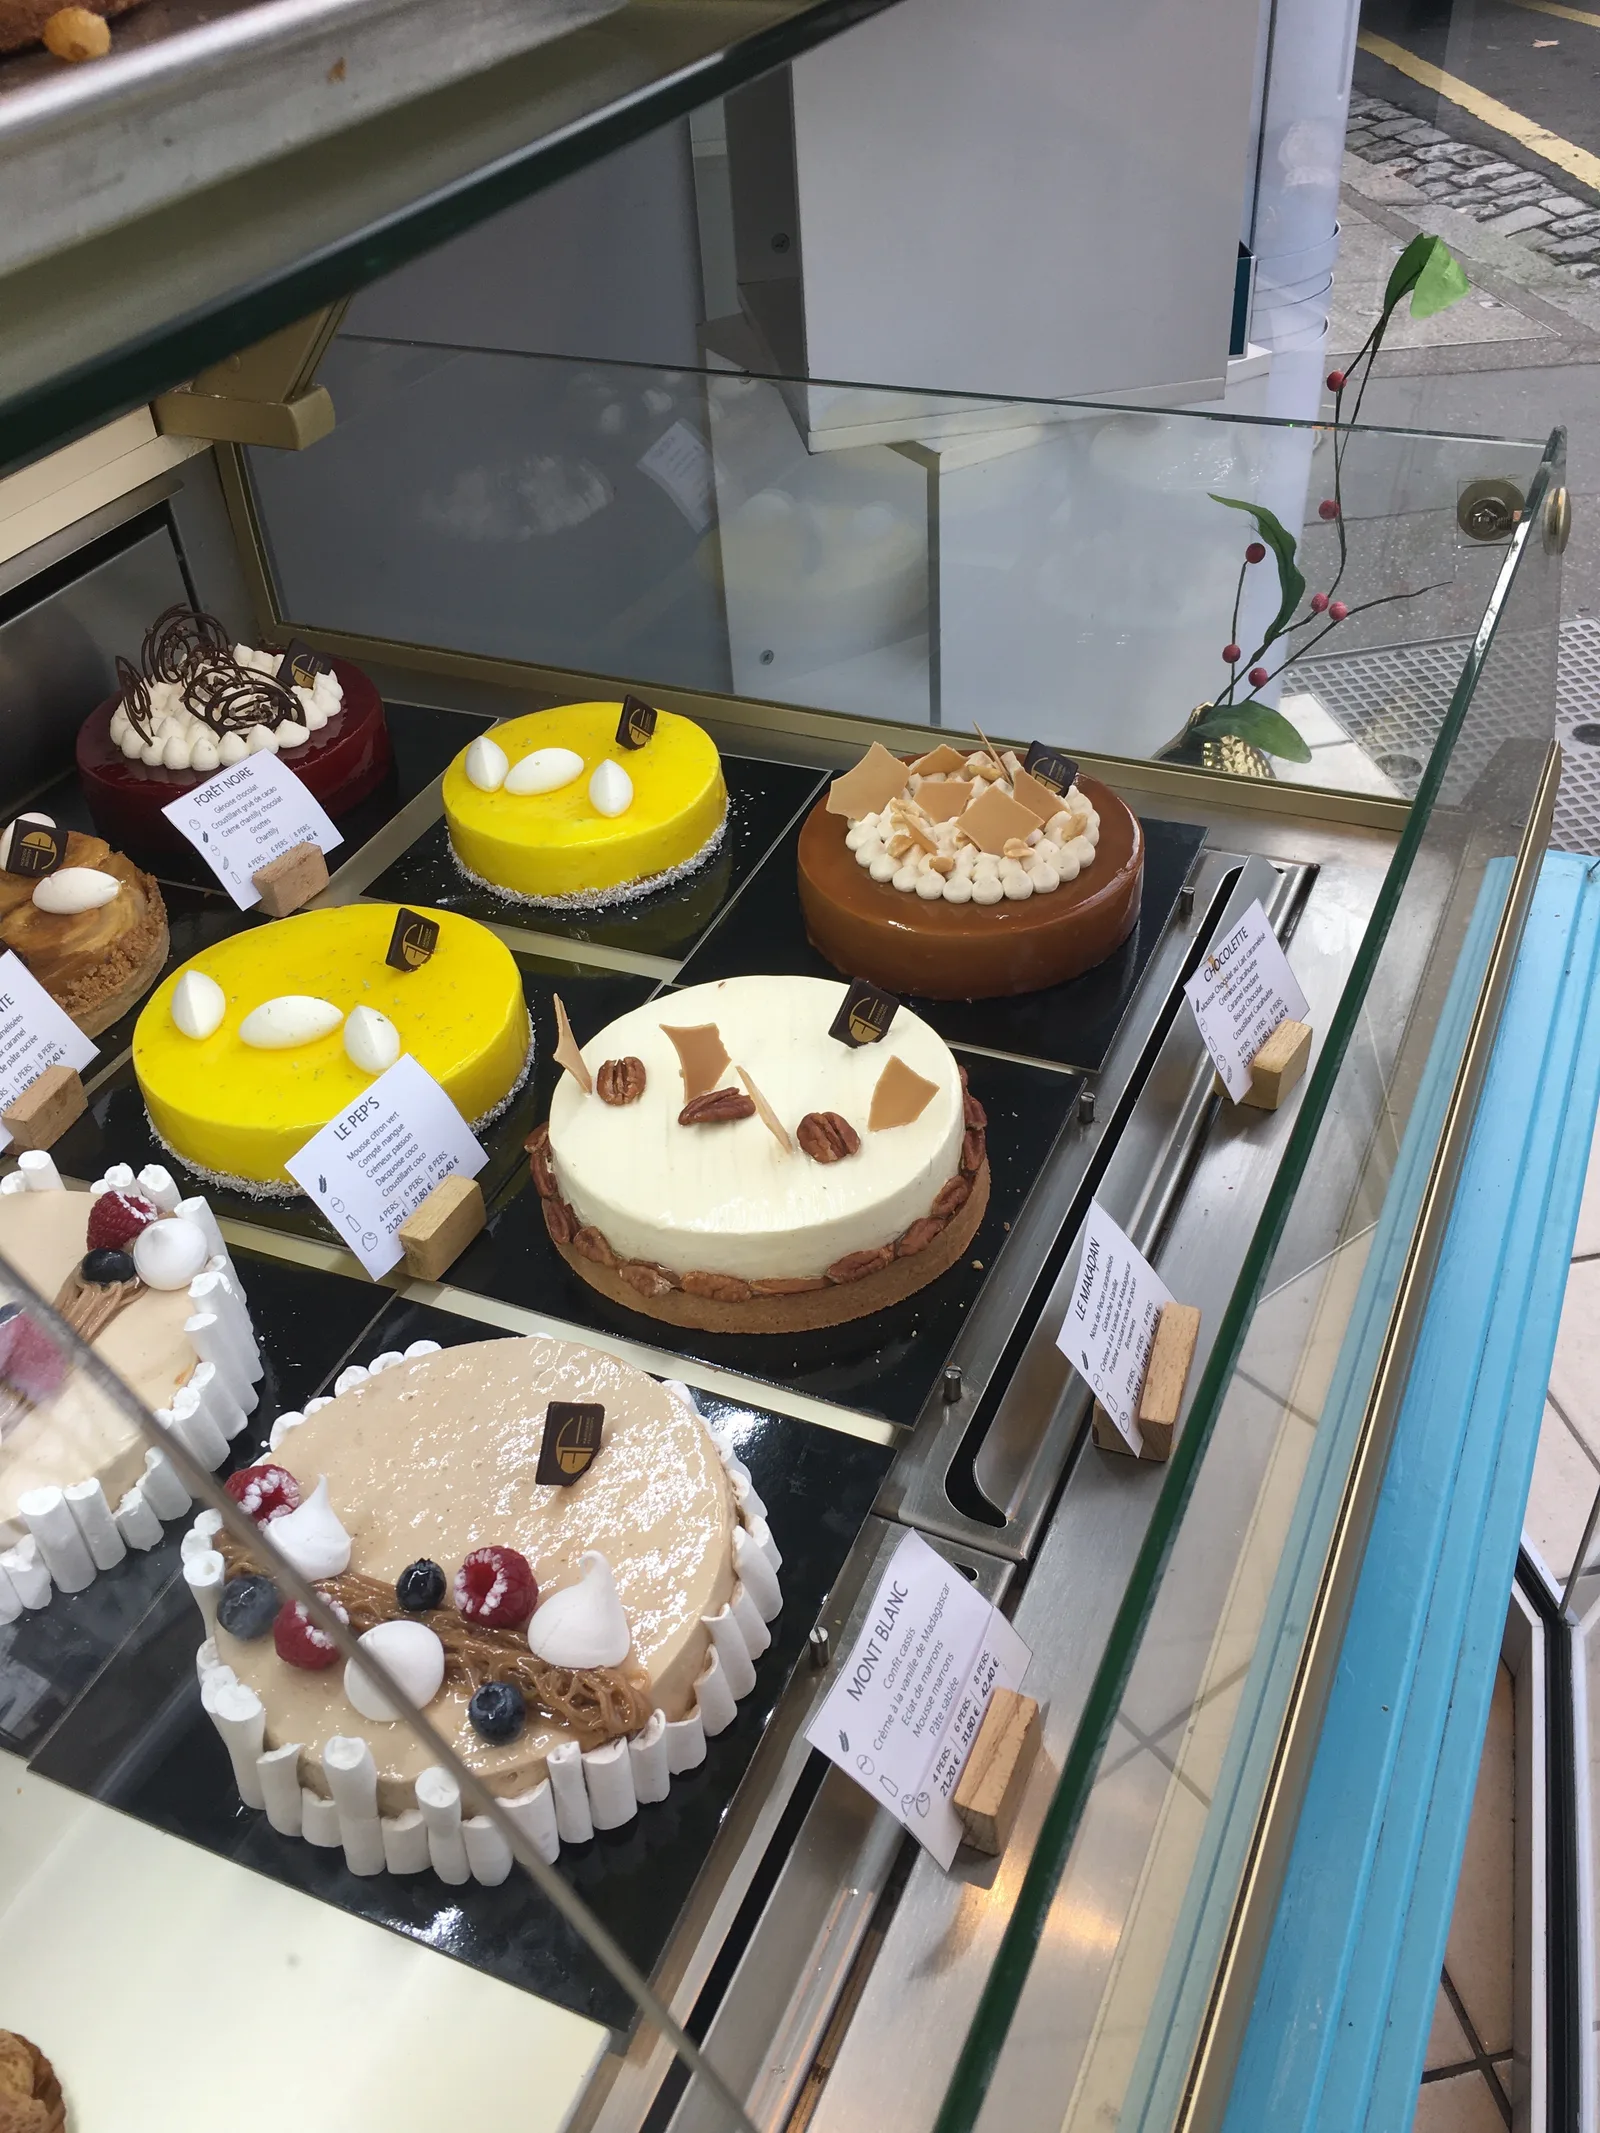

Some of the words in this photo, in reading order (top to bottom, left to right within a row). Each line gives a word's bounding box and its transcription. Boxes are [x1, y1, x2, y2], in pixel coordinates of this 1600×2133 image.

[193, 783, 225, 807] FORÊT
[222, 767, 254, 789] NOIRE
[214, 798, 237, 814] Génoise
[236, 784, 259, 801] chocolat
[211, 808, 242, 829] Croustillant
[261, 786, 277, 798] cacao
[221, 824, 241, 837] Crème
[240, 810, 262, 826] chantilly
[261, 796, 283, 812] chocolat
[249, 818, 271, 834] Griottes
[255, 827, 279, 844] Chantilly
[1204, 926, 1248, 982] CHOCOLETTE
[1199, 992, 1215, 1013] Mousse
[1214, 970, 1234, 994] Chocolat
[1233, 964, 1239, 974] au
[1238, 955, 1247, 967] Lait
[1227, 990, 1244, 1013] Caramel
[1242, 973, 1259, 994] fondant
[1233, 1004, 1247, 1023] Biscuit
[1245, 984, 1264, 1007] Chocolat
[4, 1027, 26, 1051] caramel
[1233, 1011, 1254, 1040] Croustillant
[6, 1052, 21, 1068] pâte
[20, 1035, 38, 1054] sucrée
[333, 1123, 352, 1141] LE
[347, 1096, 380, 1128] PEP'S
[346, 1139, 371, 1161] Mousse
[370, 1123, 388, 1140] citron
[386, 1111, 399, 1124] vert
[358, 1144, 382, 1168] Compté
[381, 1124, 405, 1147] mangue
[391, 1132, 413, 1156] passion
[375, 1157, 405, 1187] Dacquoise
[404, 1144, 418, 1159] coco
[382, 1165, 414, 1197] Croustillant
[413, 1152, 426, 1167] coco
[404, 1189, 410, 1197] 6
[428, 1165, 434, 1173] 8
[385, 1214, 403, 1234] 21,20
[402, 1209, 408, 1217] €
[411, 1188, 428, 1208] 31,80
[427, 1182, 433, 1191] €
[438, 1161, 454, 1180] 42,40
[453, 1155, 459, 1164] €
[1079, 1237, 1100, 1304] MAKADAN
[1119, 1261, 1131, 1301] Madagascar
[1075, 1300, 1086, 1321] LE
[1095, 1312, 1101, 1323] de
[1097, 1291, 1106, 1313] Pécan
[1102, 1302, 1113, 1332] Ganache
[1109, 1279, 1118, 1301] Vanille
[1110, 1310, 1120, 1333] Vanille
[1117, 1300, 1123, 1311] de
[1089, 1323, 1098, 1340] Noix
[1108, 1334, 1114, 1342] la
[1109, 1349, 1119, 1374] Praliné
[1117, 1322, 1126, 1350] coulant
[1127, 1297, 1132, 1308] de
[1124, 1318, 1136, 1350] Brownies
[1135, 1352, 1139, 1360] 6
[1143, 1317, 1148, 1326] 8
[1100, 1347, 1110, 1372] Crème
[921, 1583, 950, 1643] Madagascar
[846, 1638, 882, 1702] MONT
[874, 1580, 908, 1642] BLANC
[883, 1656, 902, 1689] Confit
[900, 1627, 916, 1657] cassis
[915, 1643, 926, 1658] de
[900, 1658, 919, 1691] vanille
[901, 1699, 918, 1726] Eclat
[914, 1684, 924, 1699] de
[921, 1640, 943, 1684] marrons
[890, 1704, 898, 1714] à
[893, 1693, 904, 1705] la
[912, 1696, 935, 1738] Mousse
[932, 1652, 954, 1696] marrons
[929, 1712, 944, 1736] Pâte
[941, 1677, 959, 1711] sablée
[873, 1714, 894, 1751] Crème
[933, 1773, 938, 1783] 4
[936, 1746, 952, 1775] PERS.
[954, 1723, 960, 1733] 6
[957, 1697, 972, 1724] PERS.
[974, 1675, 980, 1685] 8
[977, 1650, 990, 1676] PERS.
[940, 1765, 956, 1797] 21,20
[954, 1754, 960, 1765] €
[961, 1716, 976, 1747] 31,80
[973, 1706, 980, 1717] €
[981, 1667, 995, 1698] 42,40
[993, 1657, 999, 1668] €
